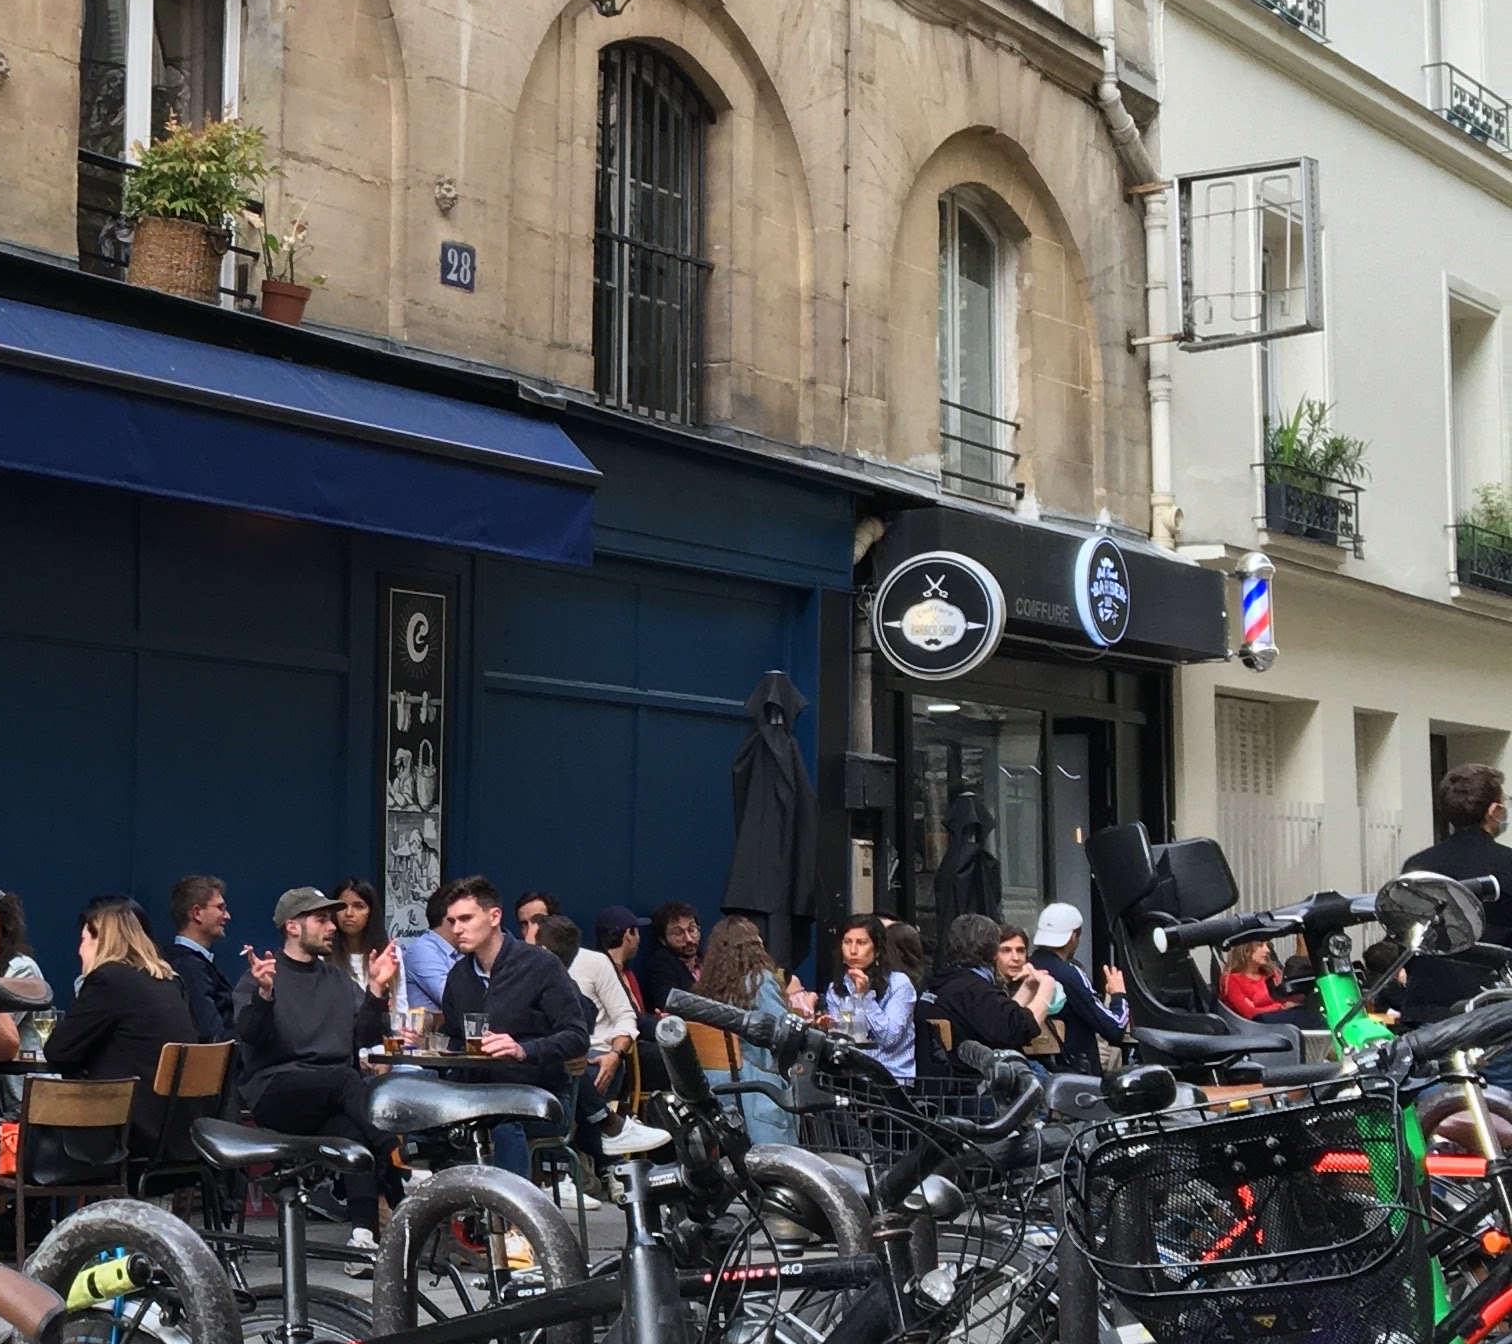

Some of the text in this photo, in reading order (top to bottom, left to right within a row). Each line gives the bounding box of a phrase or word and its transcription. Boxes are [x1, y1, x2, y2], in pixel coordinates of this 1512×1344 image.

[446, 247, 471, 285] 28
[1092, 580, 1126, 603] BARBER
[1015, 597, 1070, 624] COIFFURE
[780, 1263, 803, 1275] 4.0
